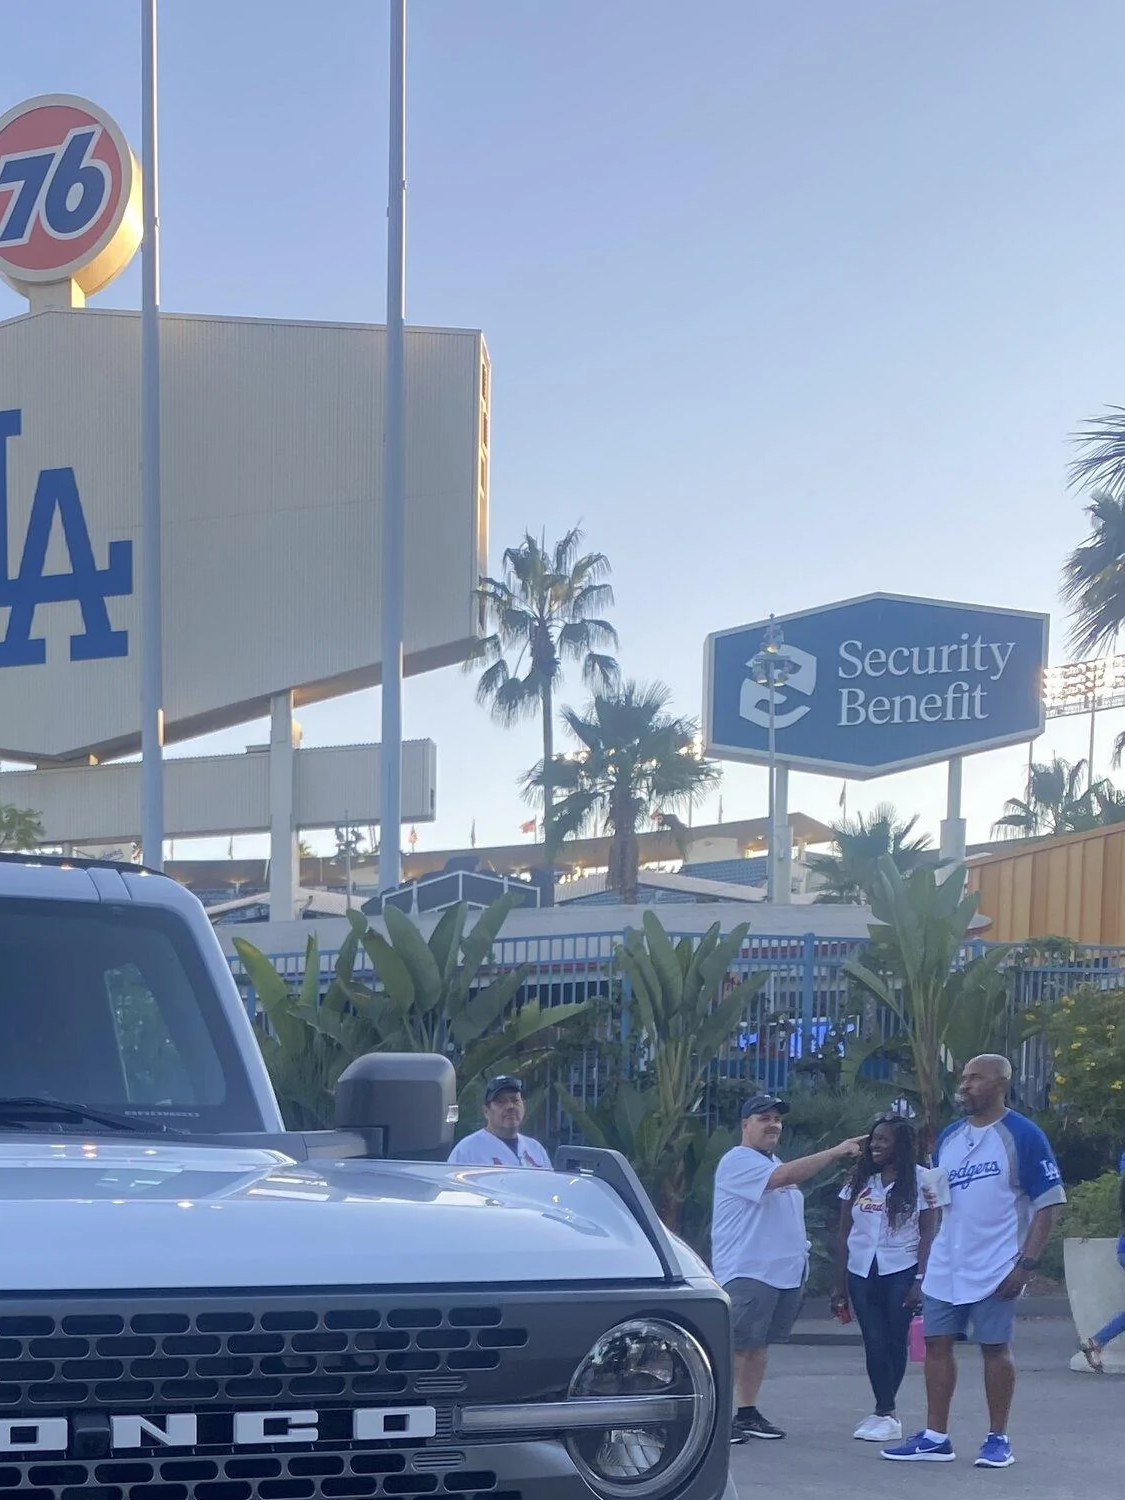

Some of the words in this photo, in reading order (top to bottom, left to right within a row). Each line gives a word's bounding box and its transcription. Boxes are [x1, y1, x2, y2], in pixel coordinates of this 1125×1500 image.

[838, 632, 1017, 680] Security
[836, 681, 989, 727] Benefit
[948, 1161, 1001, 1189] odgers
